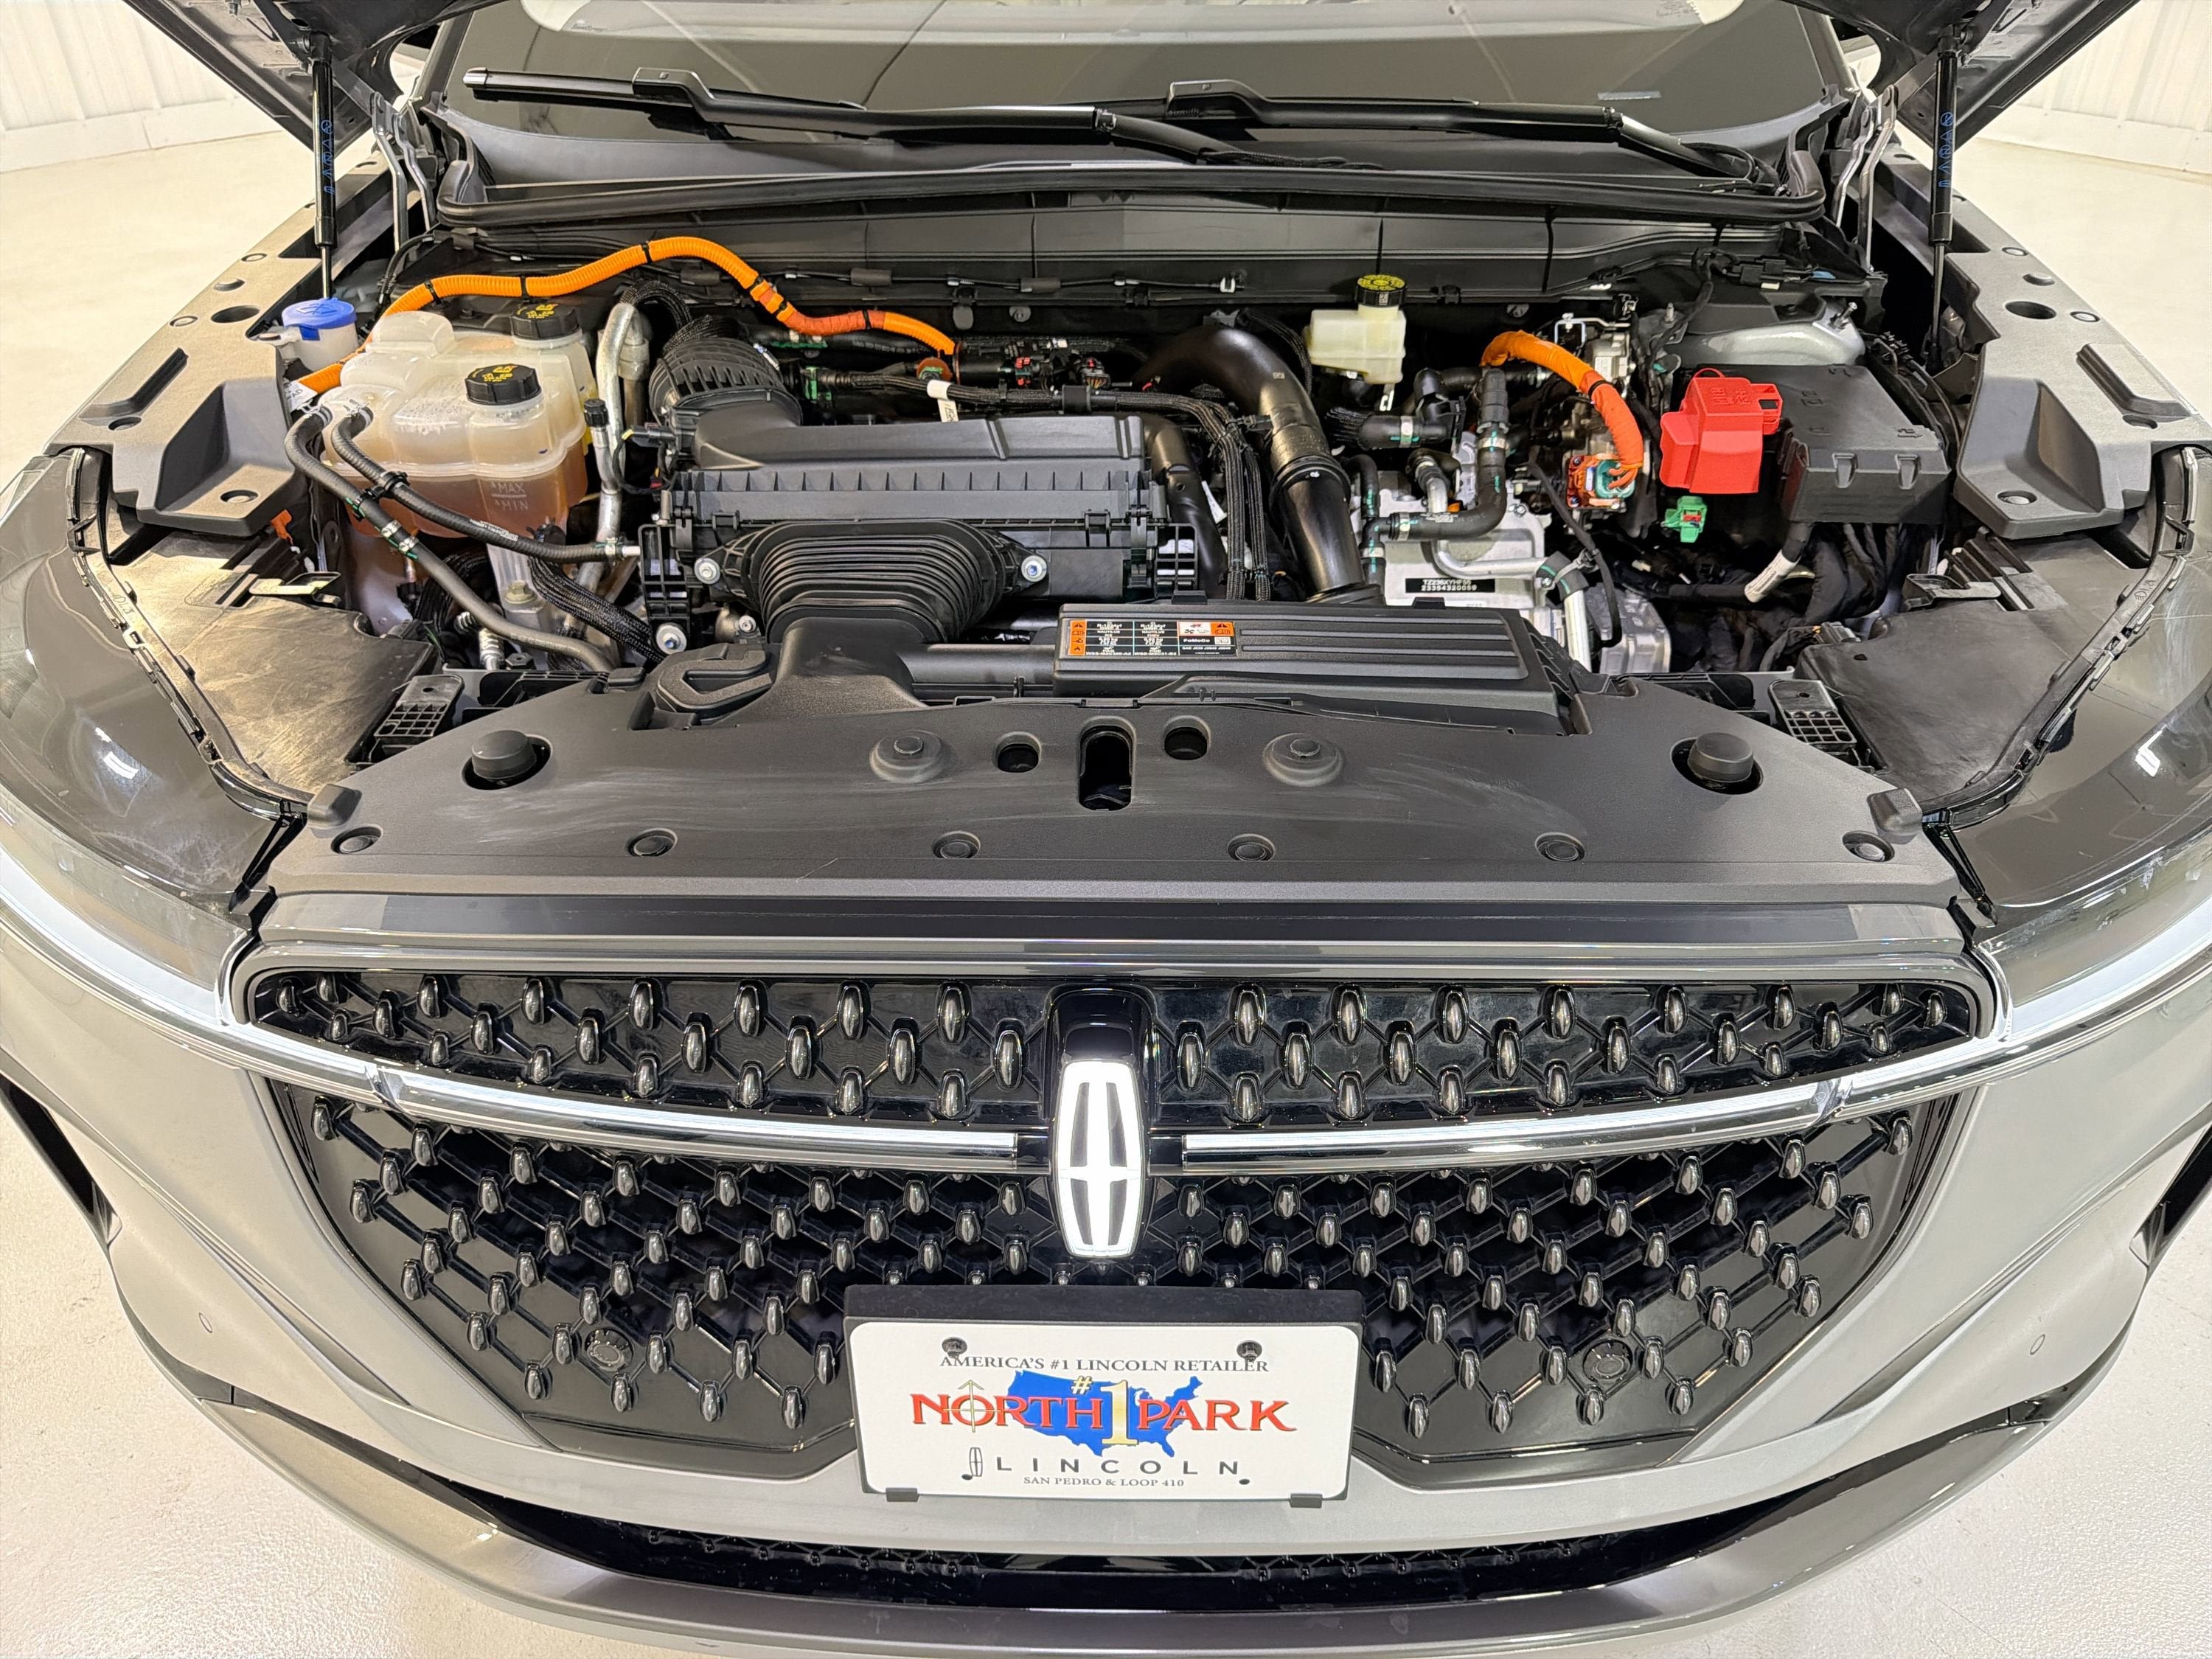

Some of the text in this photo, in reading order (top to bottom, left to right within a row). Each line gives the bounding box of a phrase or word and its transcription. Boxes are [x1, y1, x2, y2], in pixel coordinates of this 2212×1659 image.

[497, 483, 526, 494] MAX
[501, 499, 529, 511] MIN
[939, 1355, 1270, 1372] AMERICA'S #1 LINCOLN RETAILER
[910, 1394, 1104, 1429] NORTH
[1137, 1399, 1298, 1432] PARK
[996, 1456, 1239, 1475] LINCOLN
[1023, 1476, 1051, 1485] SAN
[1054, 1478, 1102, 1486] PEDRO
[1120, 1478, 1159, 1486] LOOP
[1161, 1479, 1184, 1487] 410
